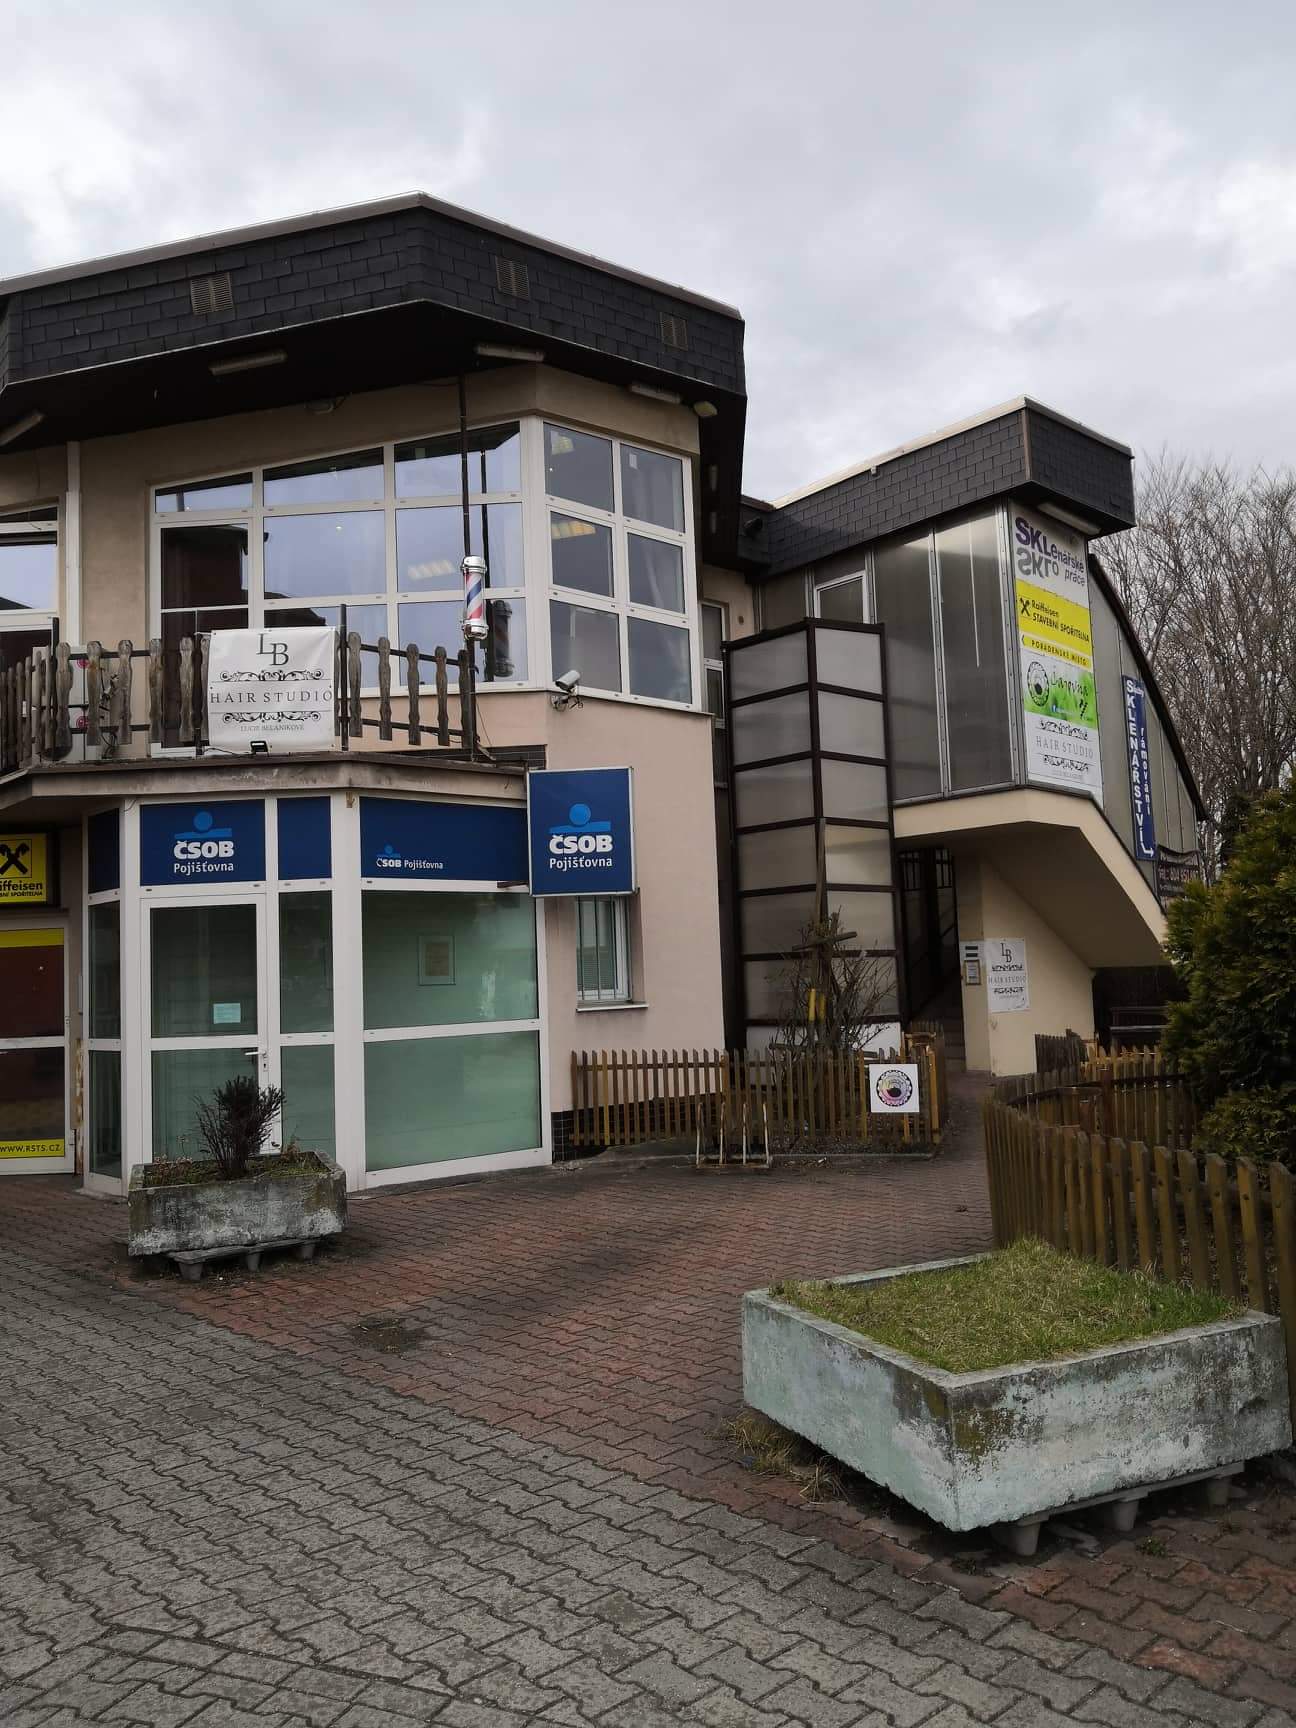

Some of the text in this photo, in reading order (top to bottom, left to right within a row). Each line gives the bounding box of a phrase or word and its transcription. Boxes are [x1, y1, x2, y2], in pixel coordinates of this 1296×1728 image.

[210, 690, 333, 704] HAIR STUDIO
[1035, 735, 1094, 759] HAIR STUDIO
[174, 840, 235, 860] ČSOB
[549, 834, 613, 854] ČSOB
[174, 860, 234, 876] Pojišťovna
[376, 857, 444, 871] ČSOB Pojišťovna
[549, 855, 613, 872] Pojišťovna
